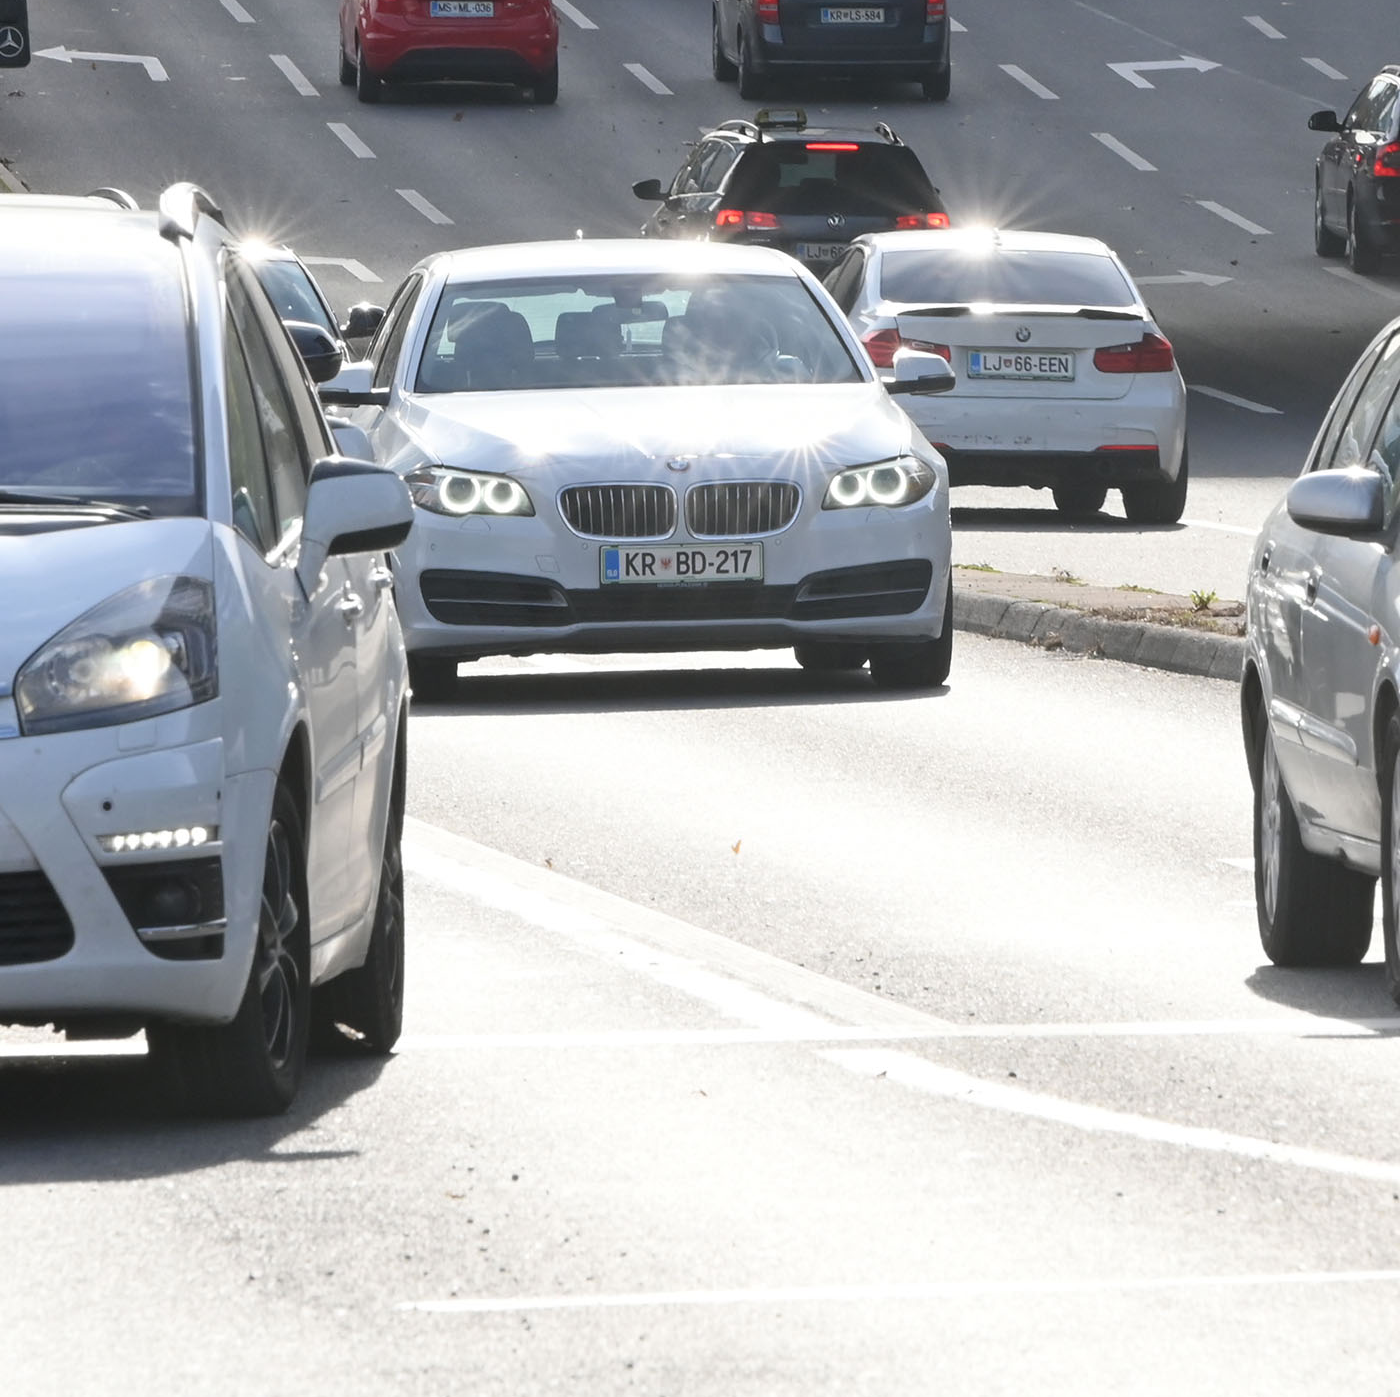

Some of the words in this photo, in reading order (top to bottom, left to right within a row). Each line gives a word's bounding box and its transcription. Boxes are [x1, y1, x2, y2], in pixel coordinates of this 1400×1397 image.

[438, 4, 451, 13] MS
[830, 11, 843, 21] KR
[806, 248, 822, 260] LJ
[983, 355, 1002, 371] LJ
[1014, 356, 1068, 373] 66-EEN
[625, 552, 656, 577] KR
[676, 549, 752, 576] BD-217
